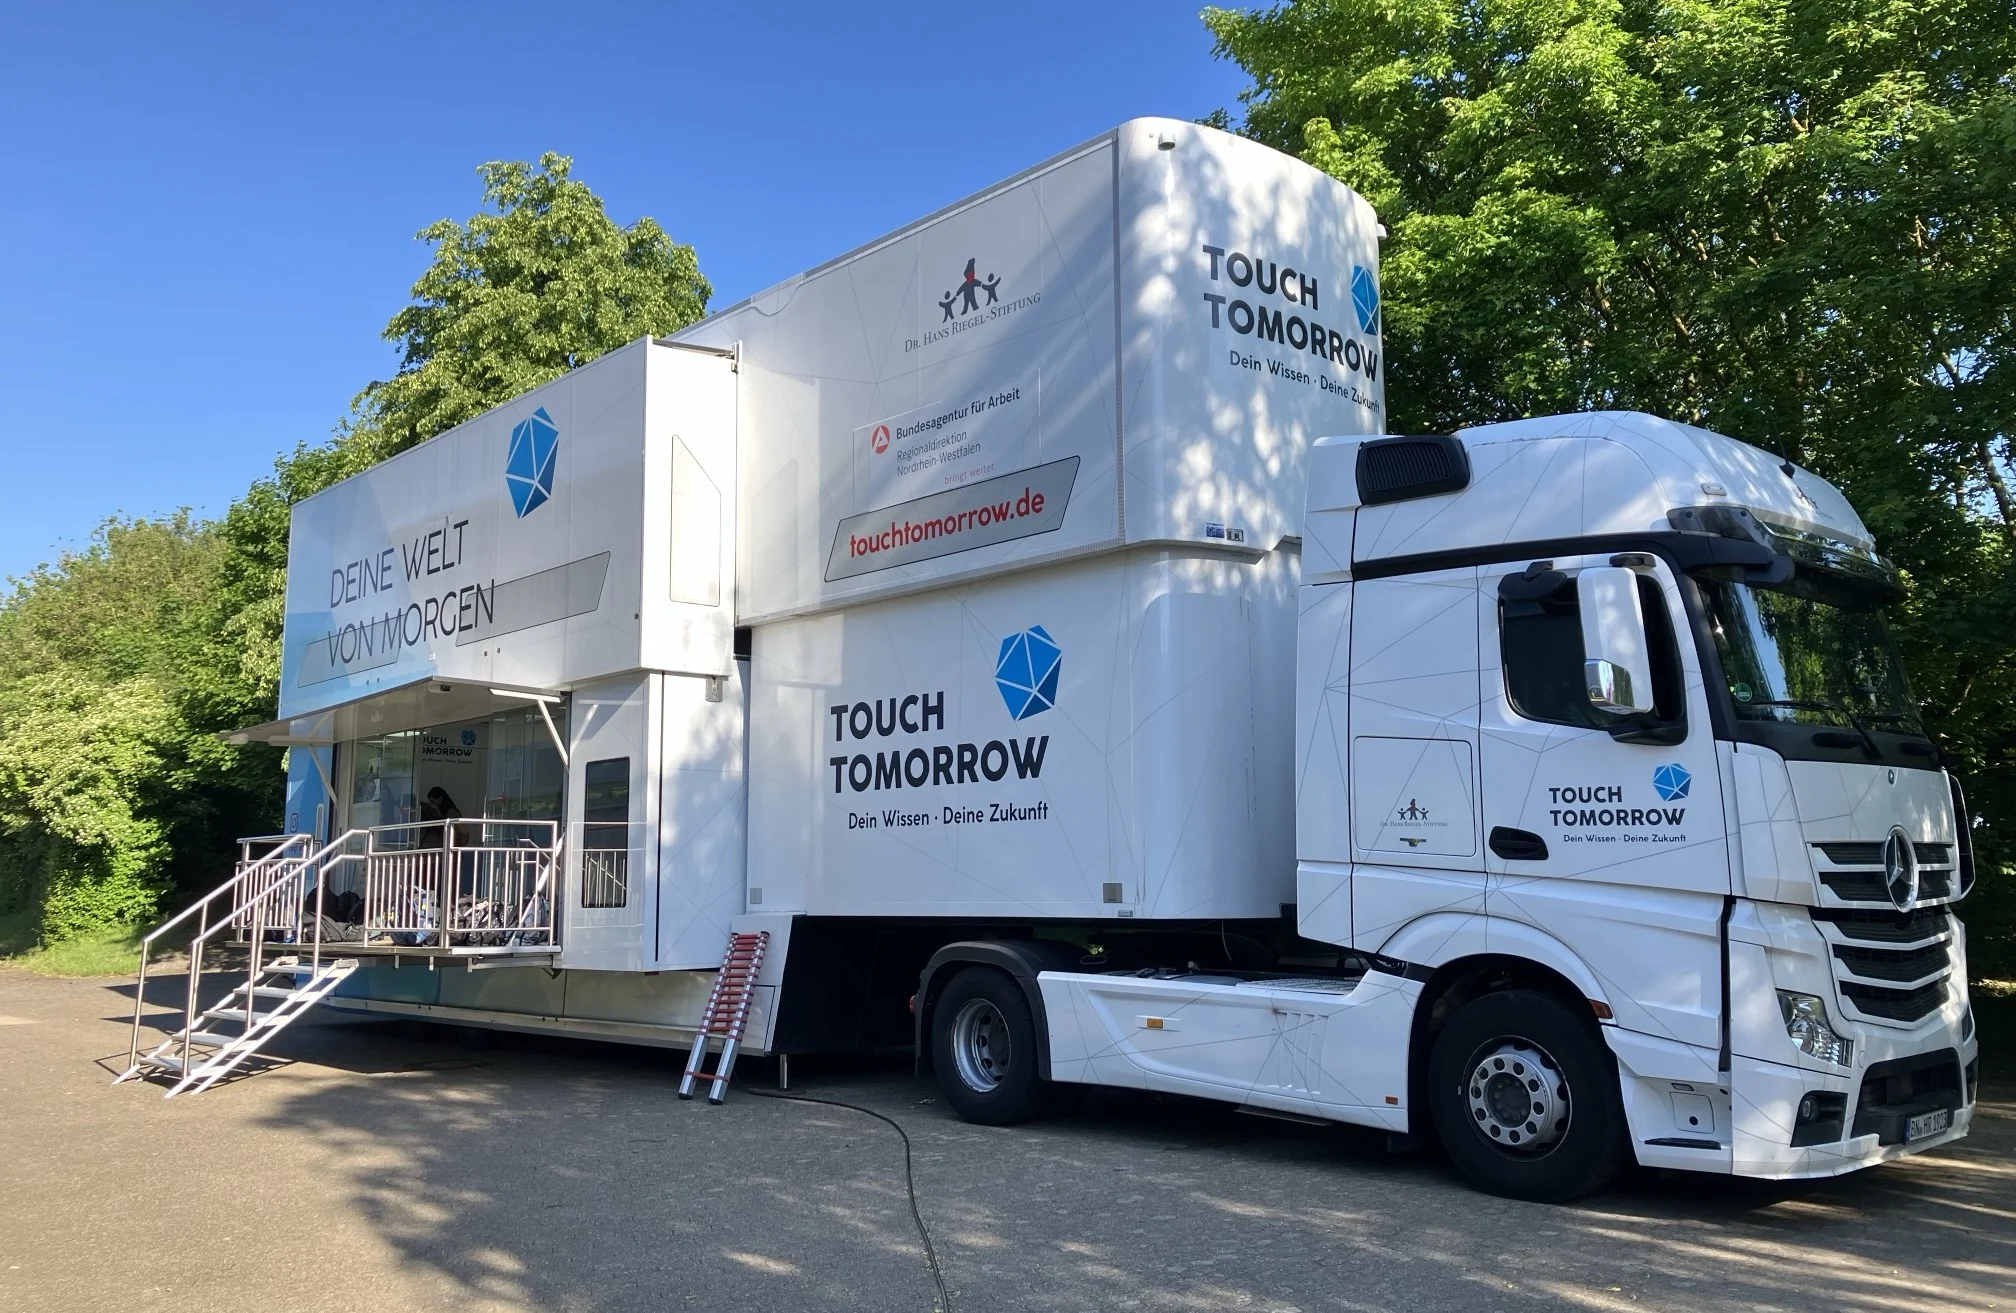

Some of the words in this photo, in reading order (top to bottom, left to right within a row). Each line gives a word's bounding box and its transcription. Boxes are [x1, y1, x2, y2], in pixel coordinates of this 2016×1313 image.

[1202, 244, 1319, 311] TOUCH
[904, 339, 921, 353] DR.
[923, 328, 950, 346] HANS
[951, 292, 1041, 335] RIEGEL-STIFTUNG
[1203, 292, 1378, 382] TOMORROW
[1229, 350, 1262, 372] Dein
[1266, 358, 1310, 385] Wissen
[1320, 375, 1349, 399] Deine
[1351, 387, 1380, 415] Zukunft
[896, 406, 969, 440] Bundesagentur
[970, 400, 986, 415] für
[987, 387, 1020, 410] Arbeit
[896, 430, 967, 462] Regionaldirektion
[897, 441, 981, 477] Nordrhein-Westfalen
[944, 471, 968, 485] bringt
[969, 463, 997, 477] weiter.
[849, 487, 1045, 558] touchtomorrow.de
[330, 547, 395, 609] DEINE
[402, 519, 469, 582] WELT
[328, 616, 375, 668] VON
[381, 578, 495, 654] MORGEN
[830, 690, 945, 742] TOUCH
[829, 735, 1050, 794] TOMORROW
[848, 812, 877, 829] Dein
[882, 809, 930, 828] Wissen
[943, 806, 984, 825] Deine
[989, 800, 1049, 823] Zukunft
[1548, 786, 1623, 804] TOUCH
[1549, 808, 1686, 827] TOMORROW
[1563, 834, 1583, 843] Dein
[1585, 834, 1616, 843] Wissen
[1623, 834, 1649, 843] Deine
[1651, 833, 1687, 843] Zukunft
